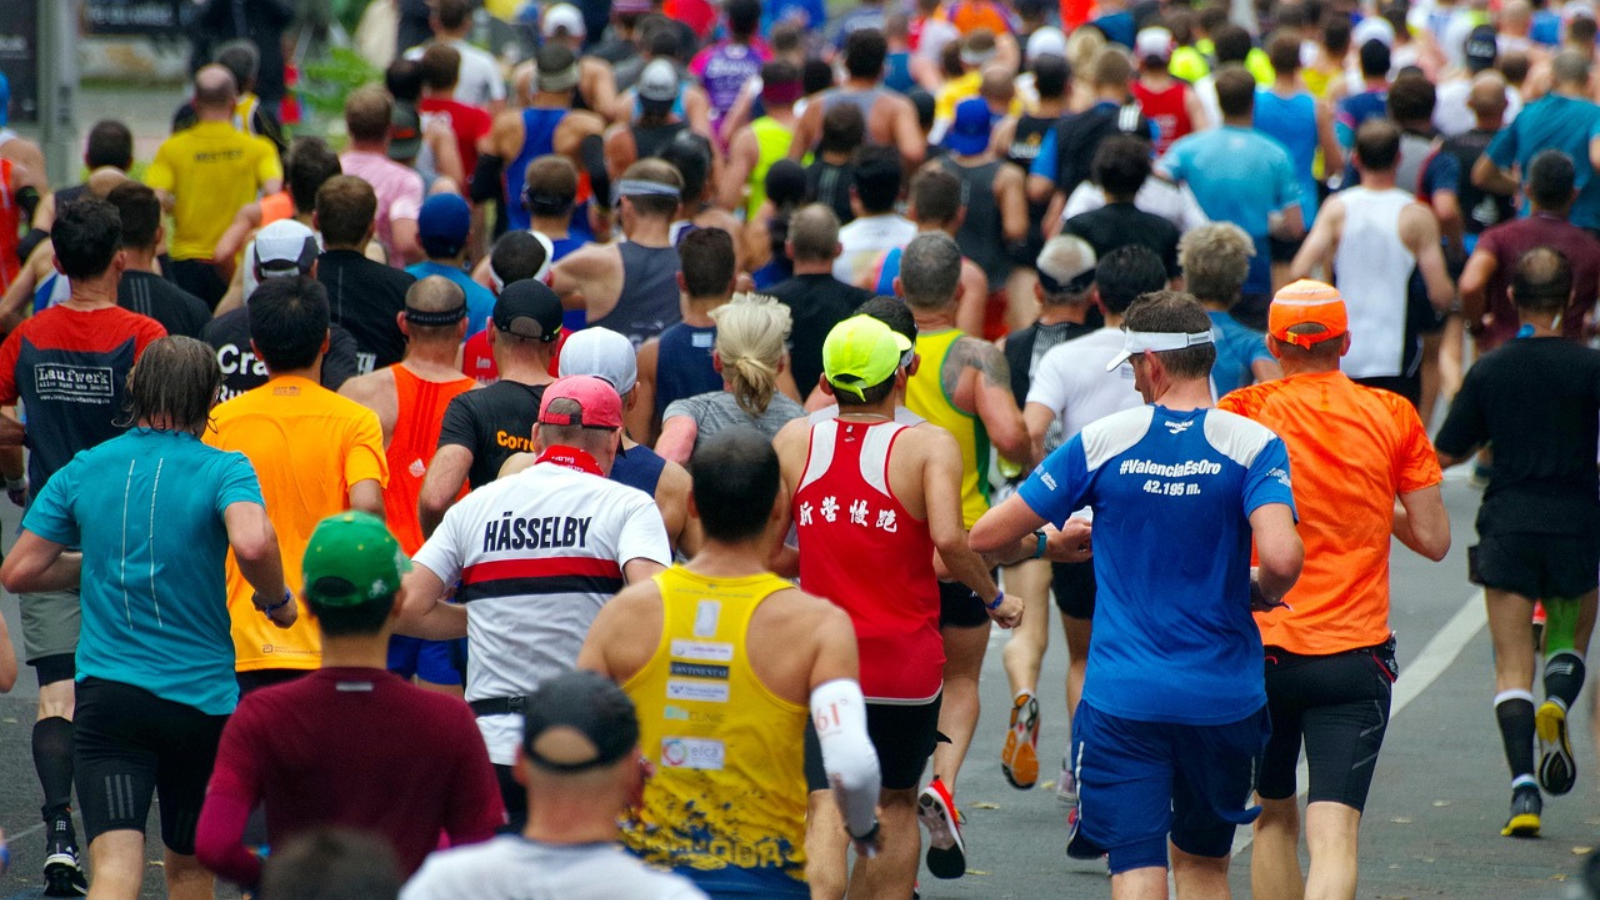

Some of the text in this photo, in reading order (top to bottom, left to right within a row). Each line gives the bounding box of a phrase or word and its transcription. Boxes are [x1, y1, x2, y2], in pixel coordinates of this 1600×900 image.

[39, 368, 109, 384] Laufwerk
[1119, 459, 1221, 478] #ValenciaEsOro
[1143, 479, 1201, 496] 42.195 m.
[483, 510, 593, 553] HÄSSELBY
